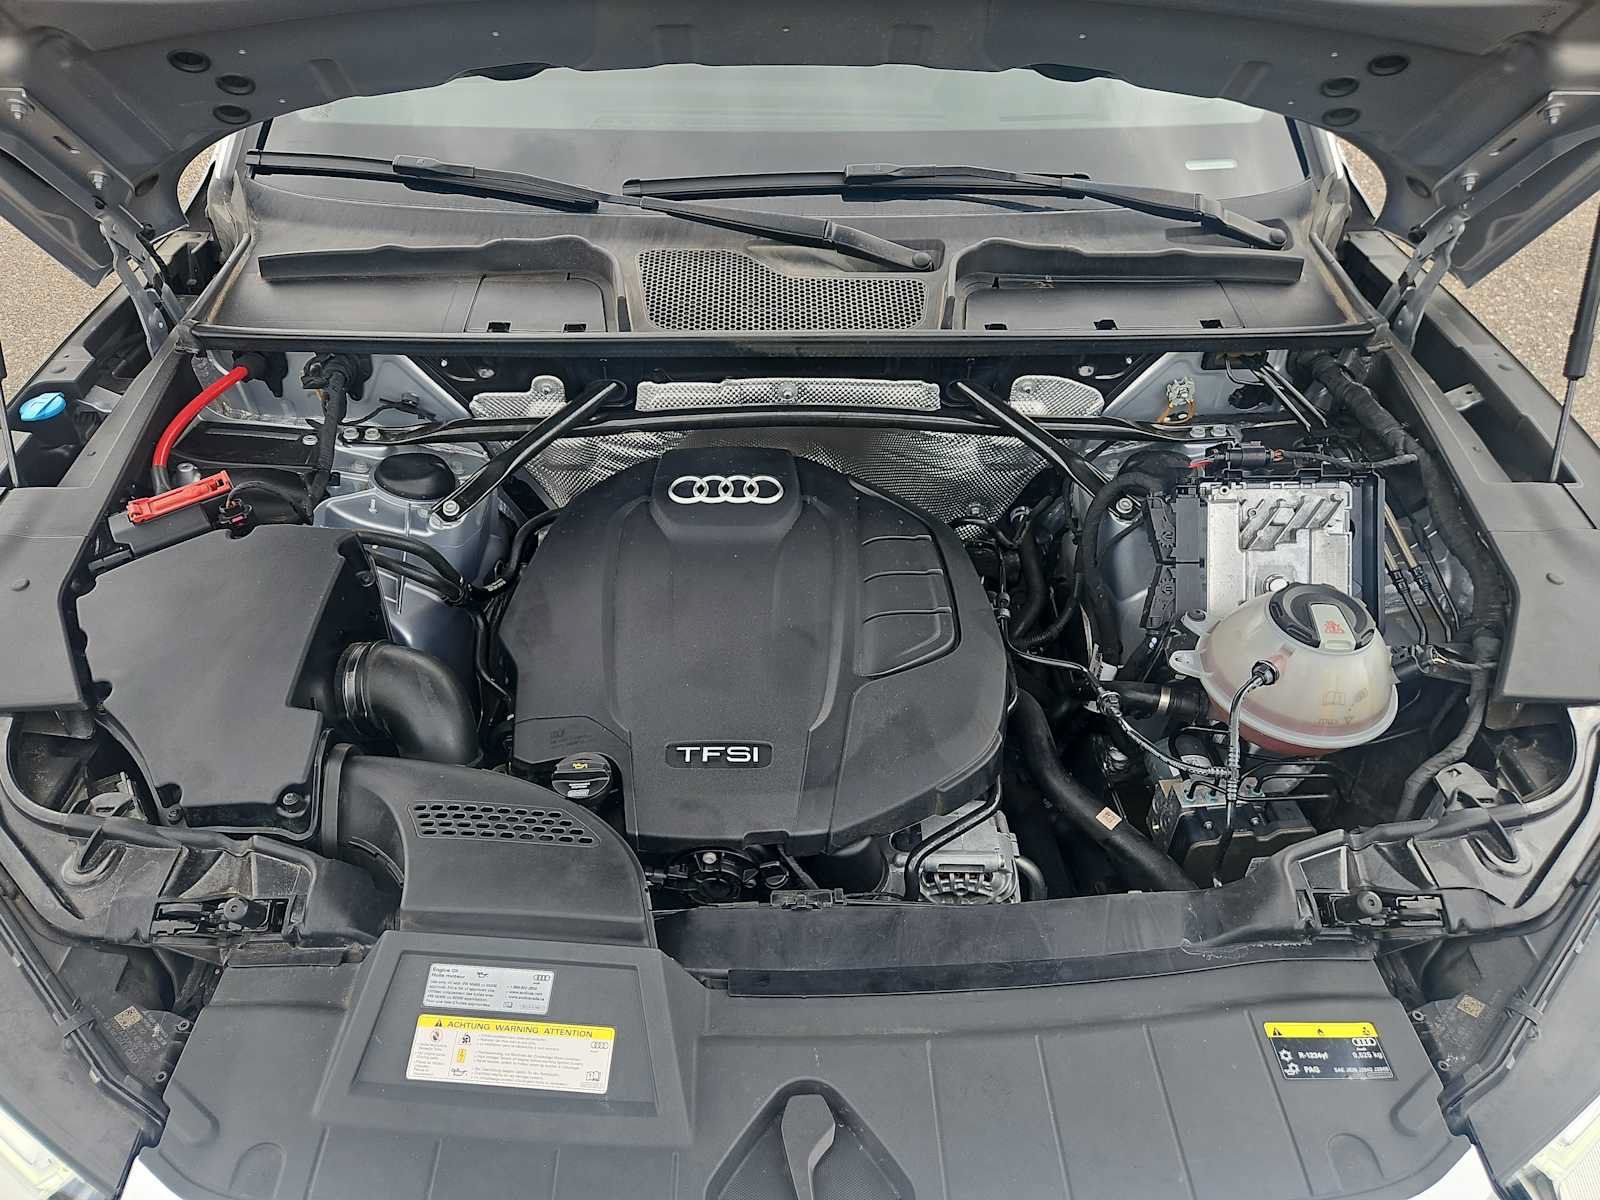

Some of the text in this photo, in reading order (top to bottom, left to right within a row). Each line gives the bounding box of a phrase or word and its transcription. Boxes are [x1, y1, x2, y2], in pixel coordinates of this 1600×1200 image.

[676, 746, 759, 762] TFSI
[447, 1021, 593, 1038] ACHTUNG WARNING ATTENTION
